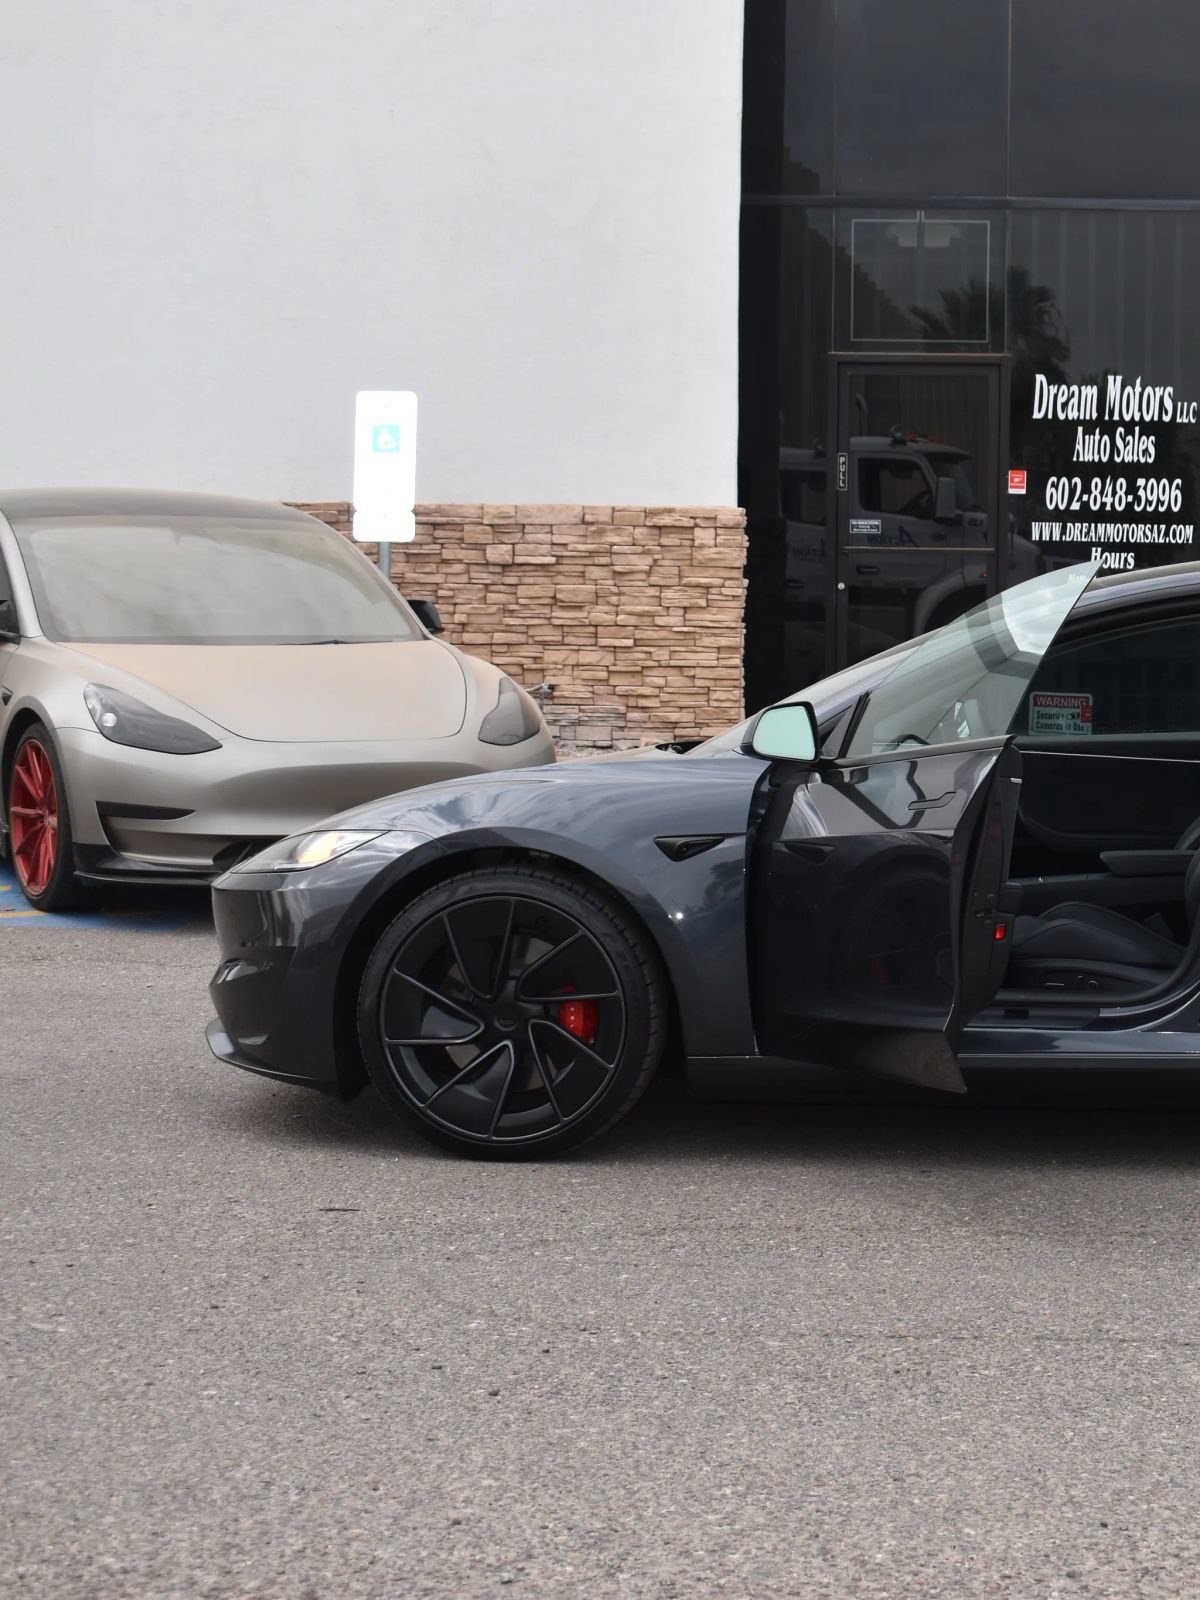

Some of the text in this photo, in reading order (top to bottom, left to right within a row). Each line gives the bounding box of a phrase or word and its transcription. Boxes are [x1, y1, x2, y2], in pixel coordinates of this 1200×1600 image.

[1032, 374, 1198, 424] Dream Motors LLC
[1073, 426, 1156, 464] Auto Sales
[1045, 475, 1182, 512] 602-848-3996
[1031, 521, 1194, 544] WWW.DREAMMOTORSAZ.COM
[1091, 547, 1135, 569] Hours
[1036, 695, 1086, 708] WARNING
[1036, 710, 1065, 721] Security
[1036, 720, 1064, 731] Cameras
